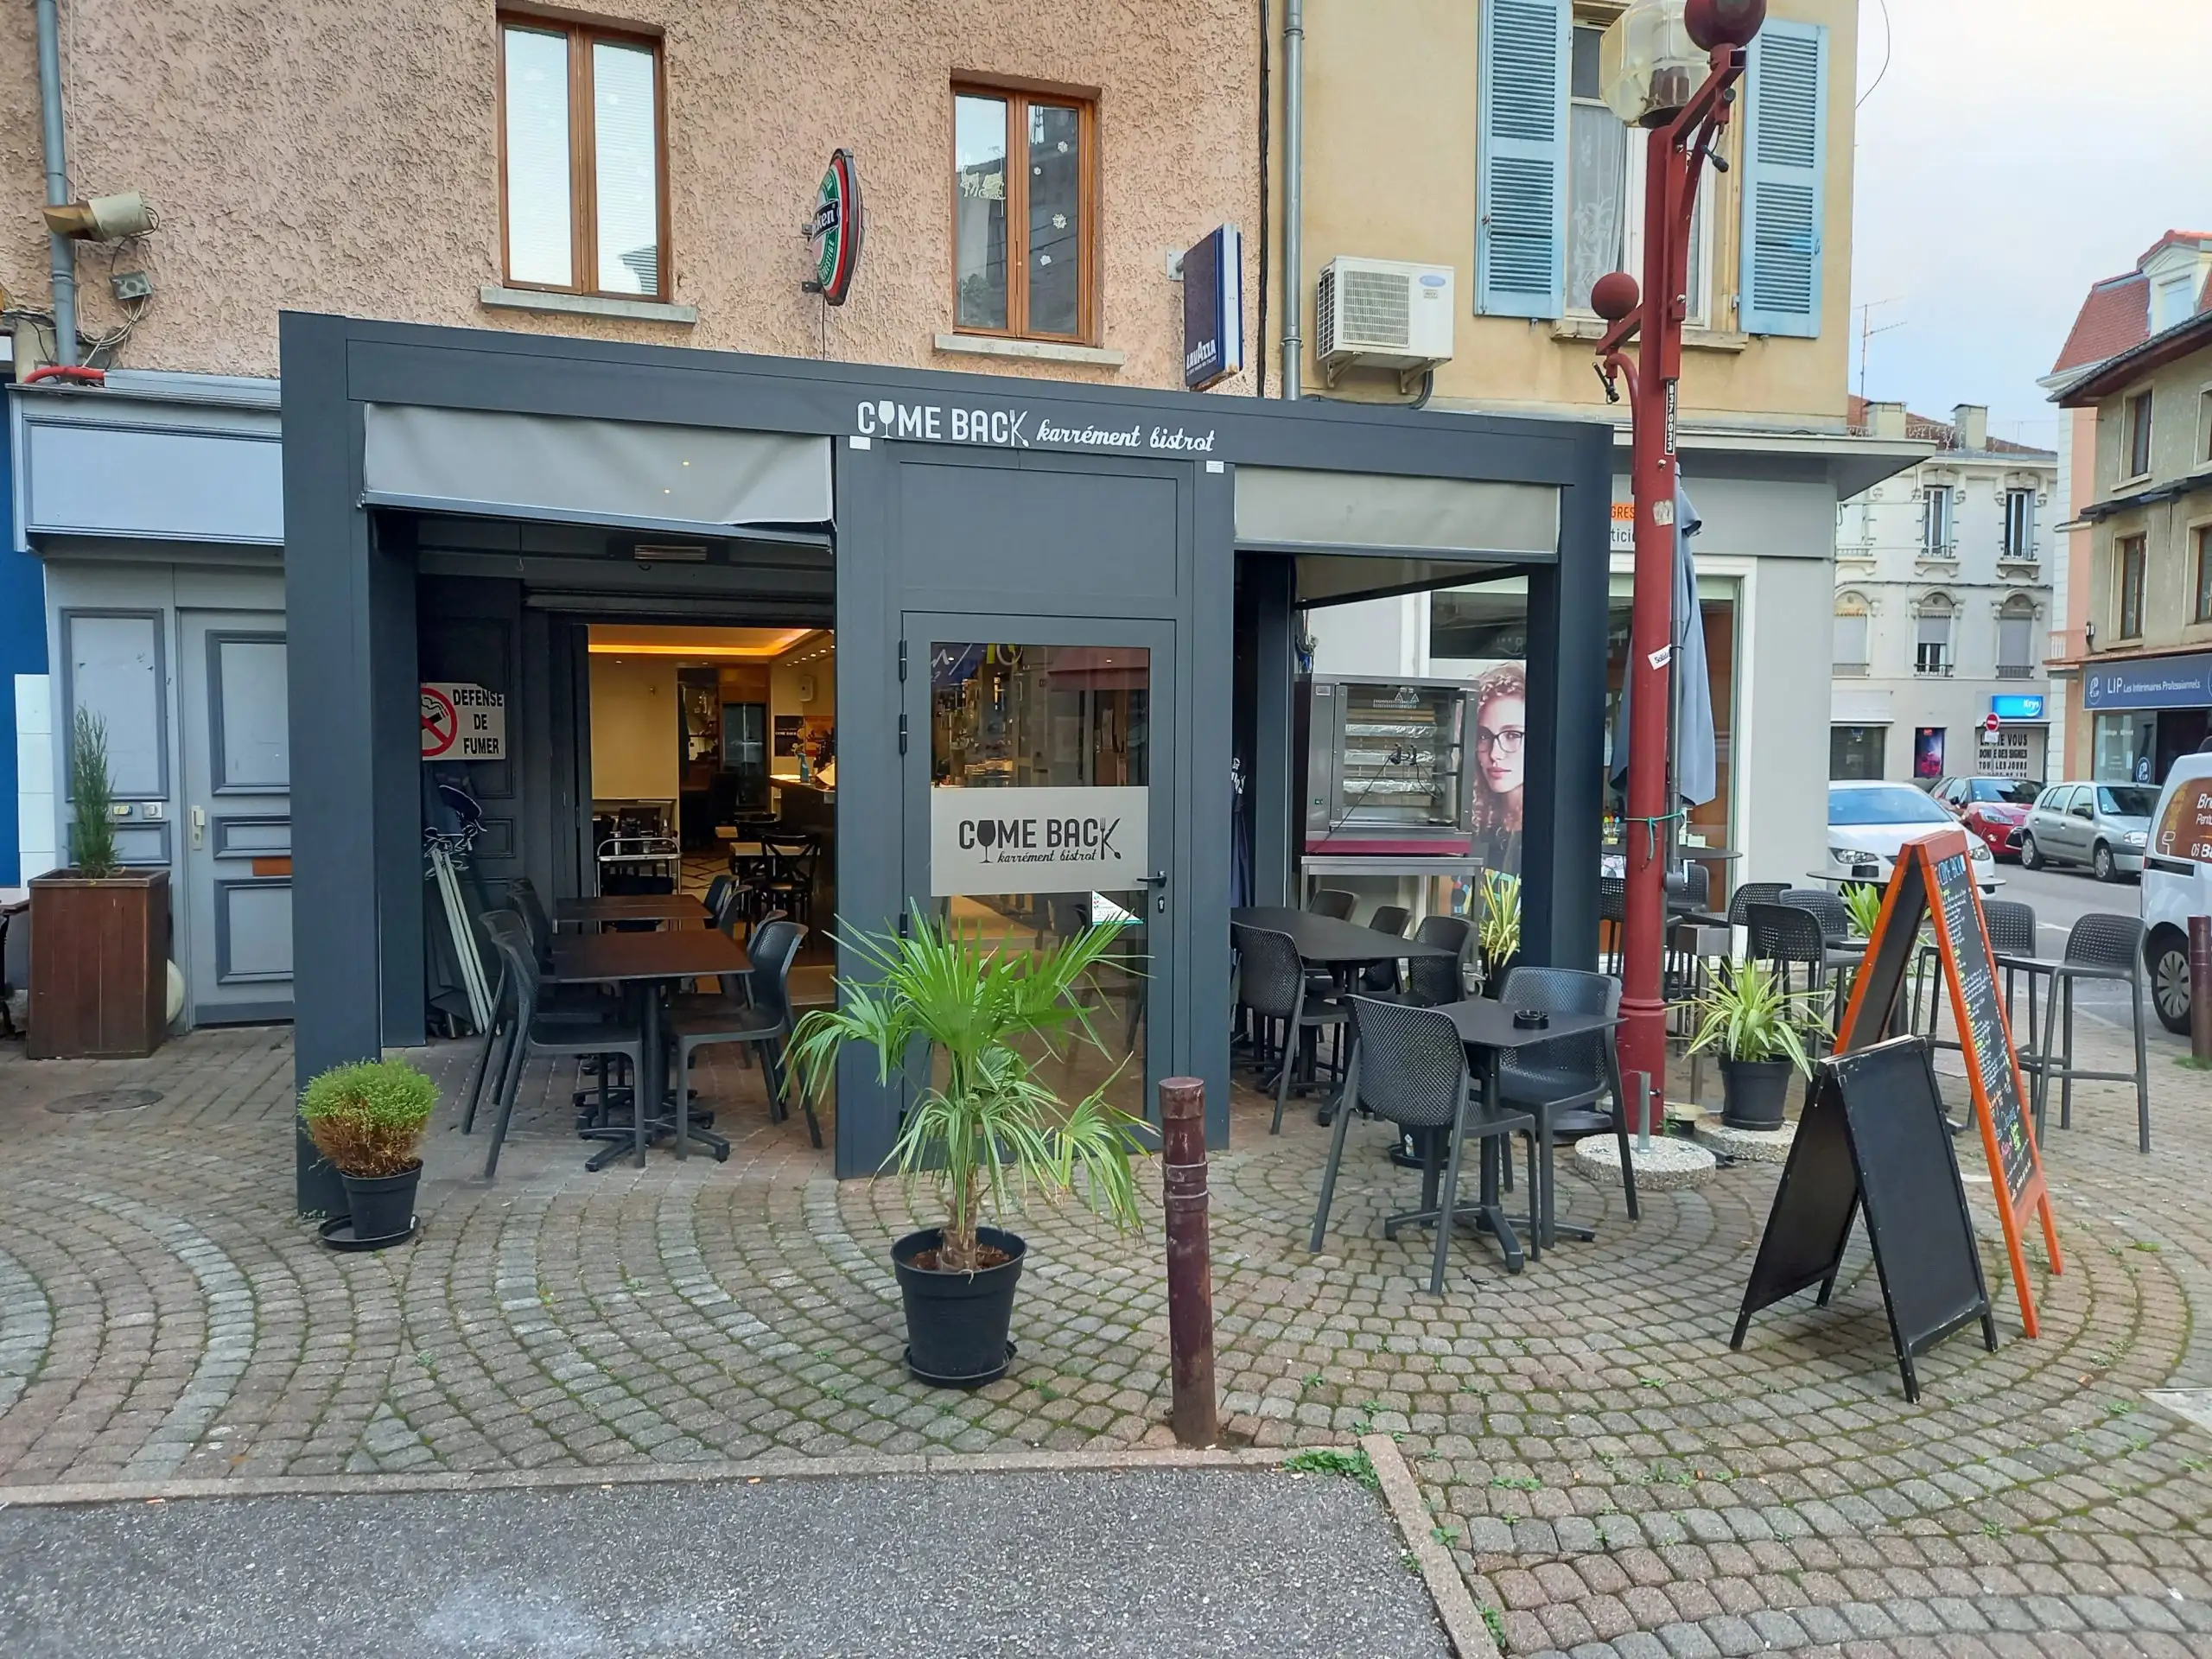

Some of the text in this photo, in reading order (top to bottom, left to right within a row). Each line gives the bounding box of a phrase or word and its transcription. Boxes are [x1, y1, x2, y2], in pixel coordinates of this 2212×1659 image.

[1186, 339, 1217, 371] LAVAZZA
[951, 408, 1030, 448] BACK
[1036, 418, 1141, 448] karrément
[1149, 426, 1216, 452] bistrot
[1610, 528, 1635, 543] tici
[2107, 677, 2123, 694] LIP
[452, 689, 504, 707] DEFENSE
[473, 714, 488, 730] DE
[463, 737, 499, 754] FUMER
[2008, 734, 2028, 747] VOUS
[1979, 748, 1998, 759] DONE
[1998, 749, 2008, 759] DES
[1979, 761, 2027, 770] TOU LES JOURS
[1046, 817, 1122, 861] BACK
[997, 849, 1097, 863] karrément bistrot
